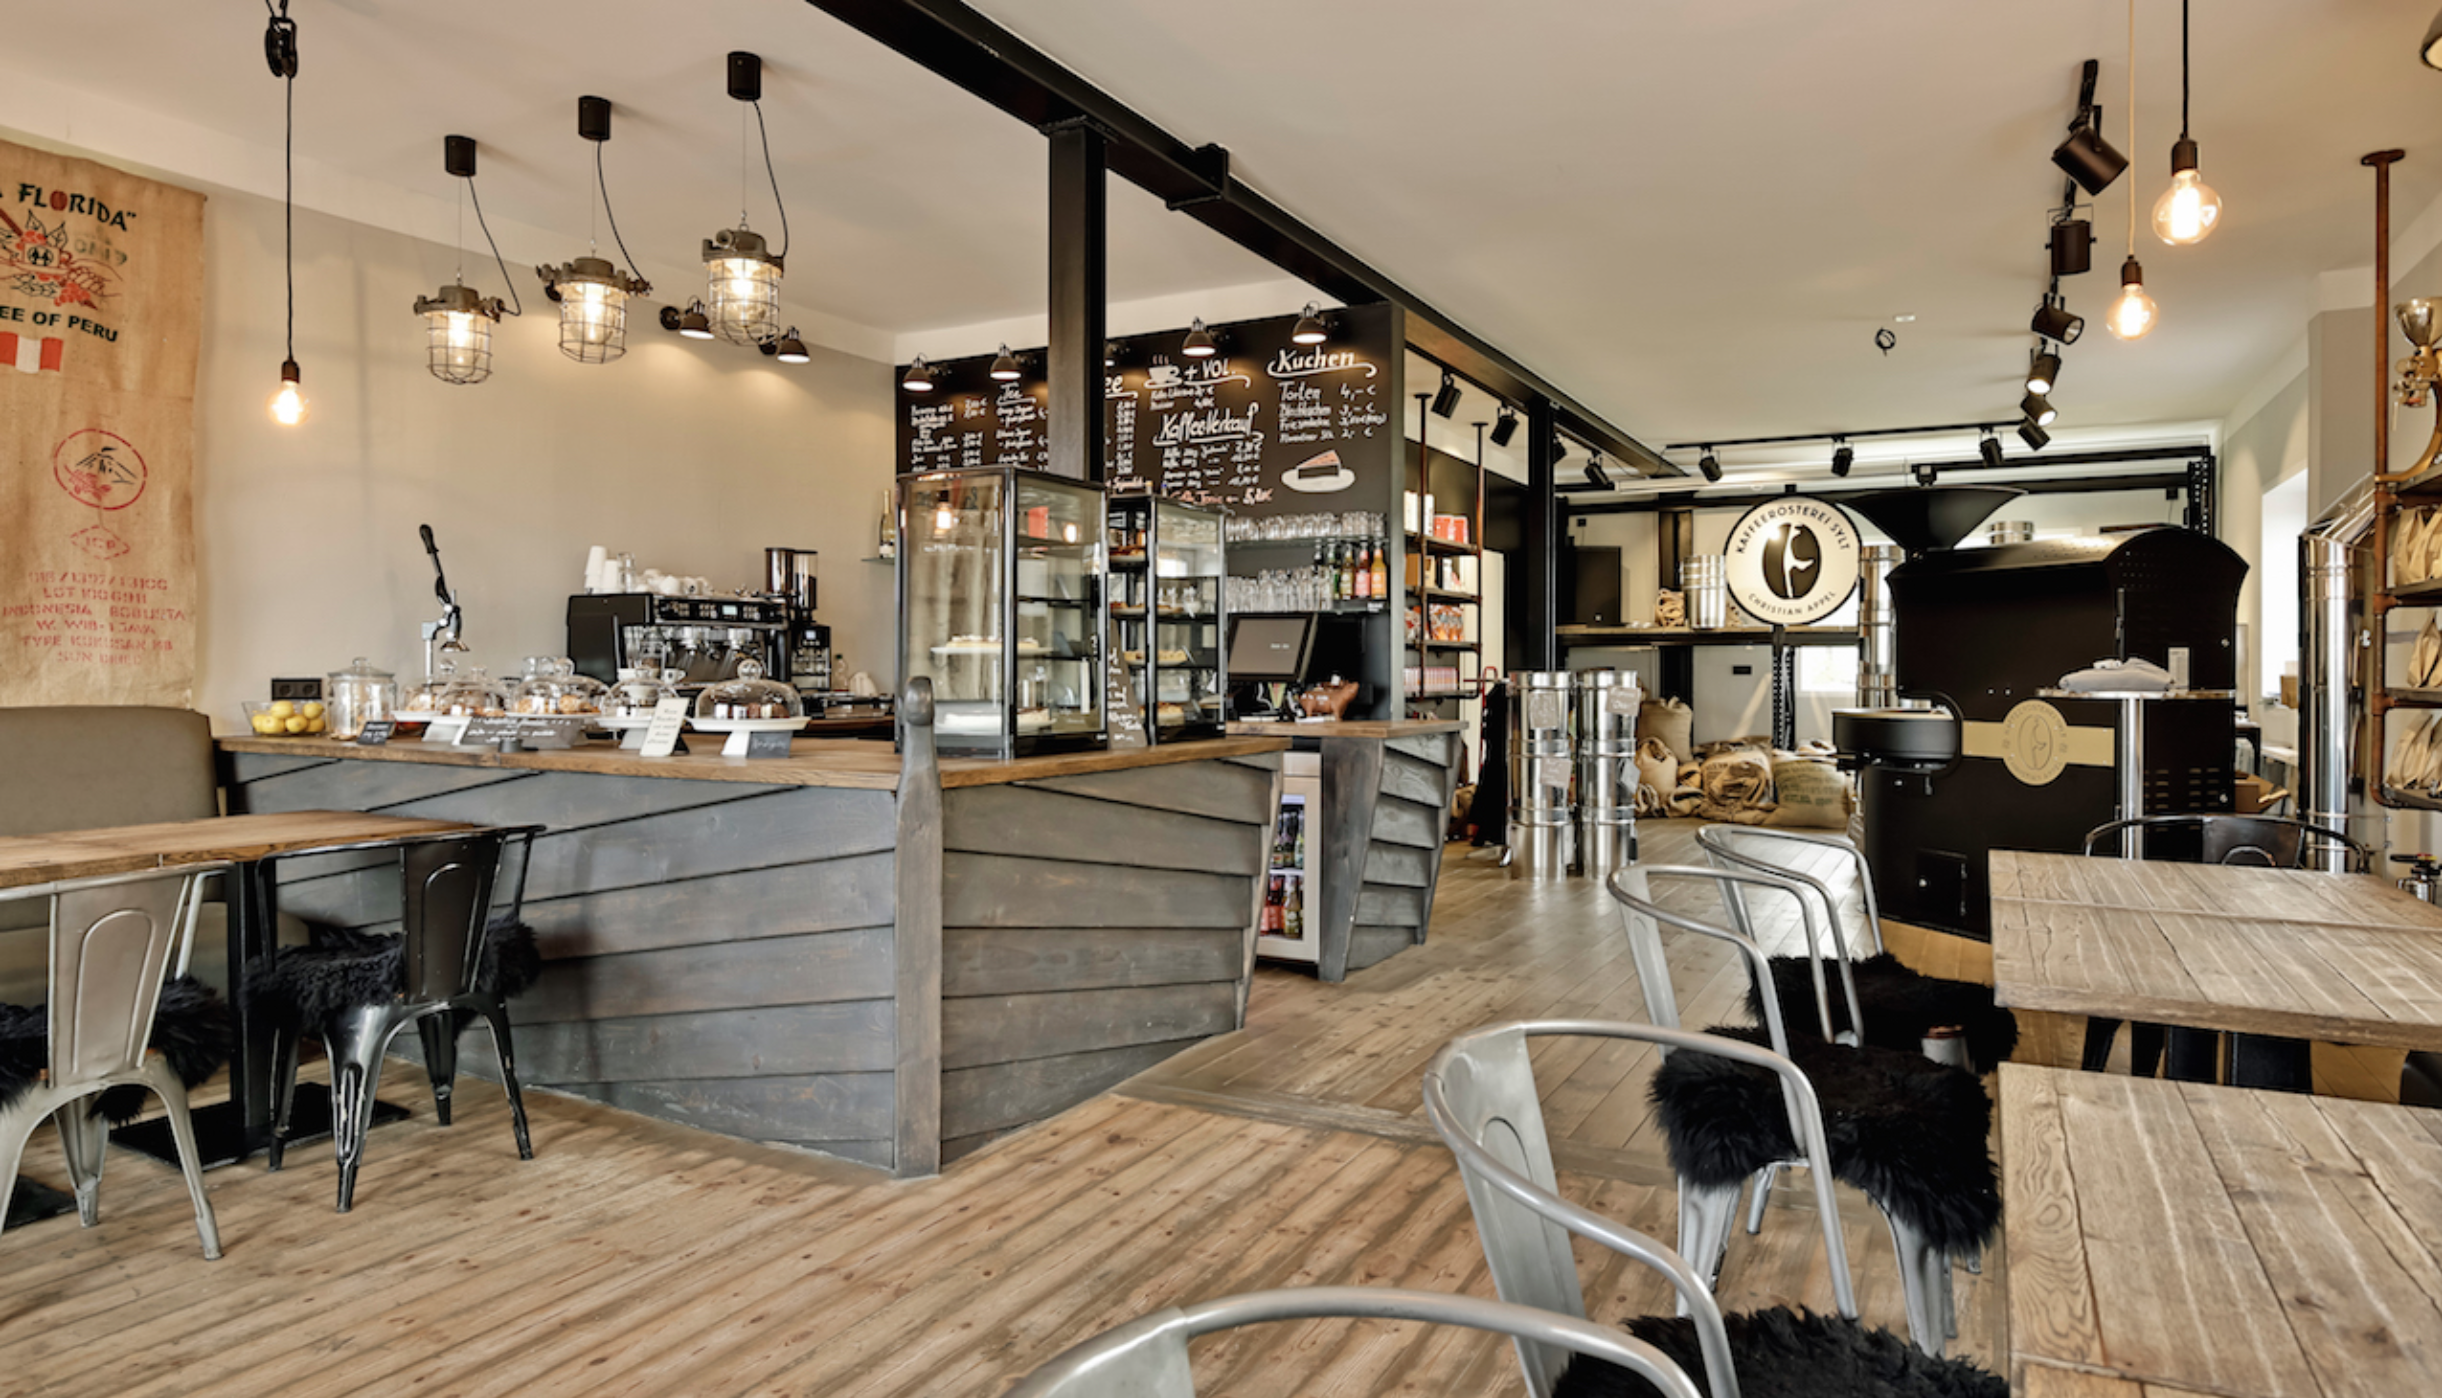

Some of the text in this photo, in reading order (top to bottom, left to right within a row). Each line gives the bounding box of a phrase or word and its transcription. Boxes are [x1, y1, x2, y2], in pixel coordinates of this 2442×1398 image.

[32, 312, 61, 326] OF
[67, 315, 118, 342] PERU
[1277, 345, 1355, 372] Kuchen
[1278, 381, 1321, 400] Torten
[1829, 523, 1850, 550] SYLT
[43, 587, 76, 599] LOT
[1748, 590, 1836, 615] CHRISTIAN APPEL
[3, 603, 186, 621] INDONESIA ROBUSTA
[22, 635, 62, 647] TYPE
[57, 652, 93, 663] SUN
